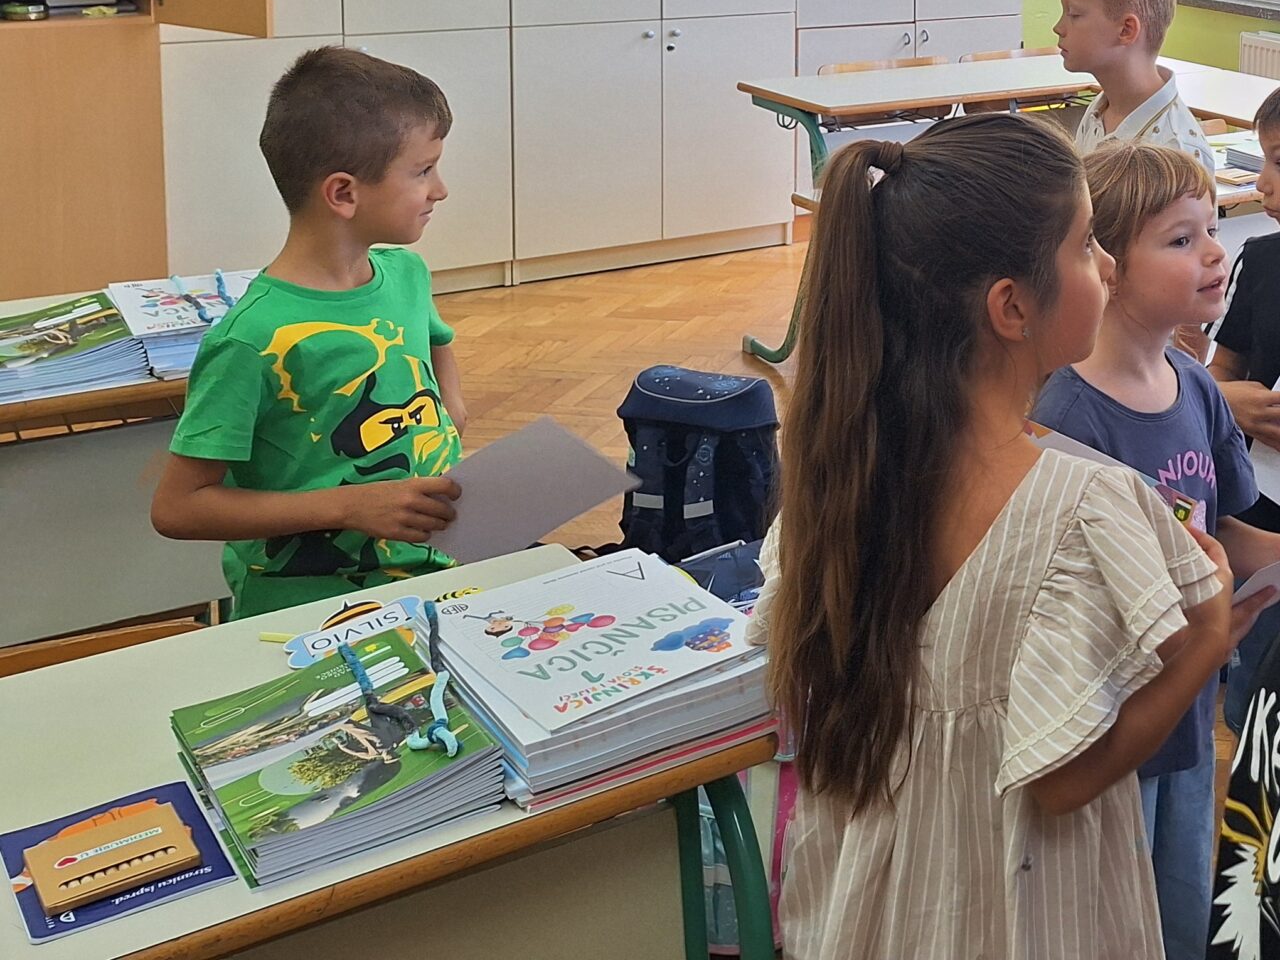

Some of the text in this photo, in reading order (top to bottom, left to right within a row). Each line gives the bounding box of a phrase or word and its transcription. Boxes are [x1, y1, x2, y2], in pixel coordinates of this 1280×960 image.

[310, 611, 399, 651] SILVIO
[516, 597, 707, 682] PISANČICA
[552, 665, 669, 715] ŠKRINJICA
[110, 865, 213, 906] Stranicu ispred.
